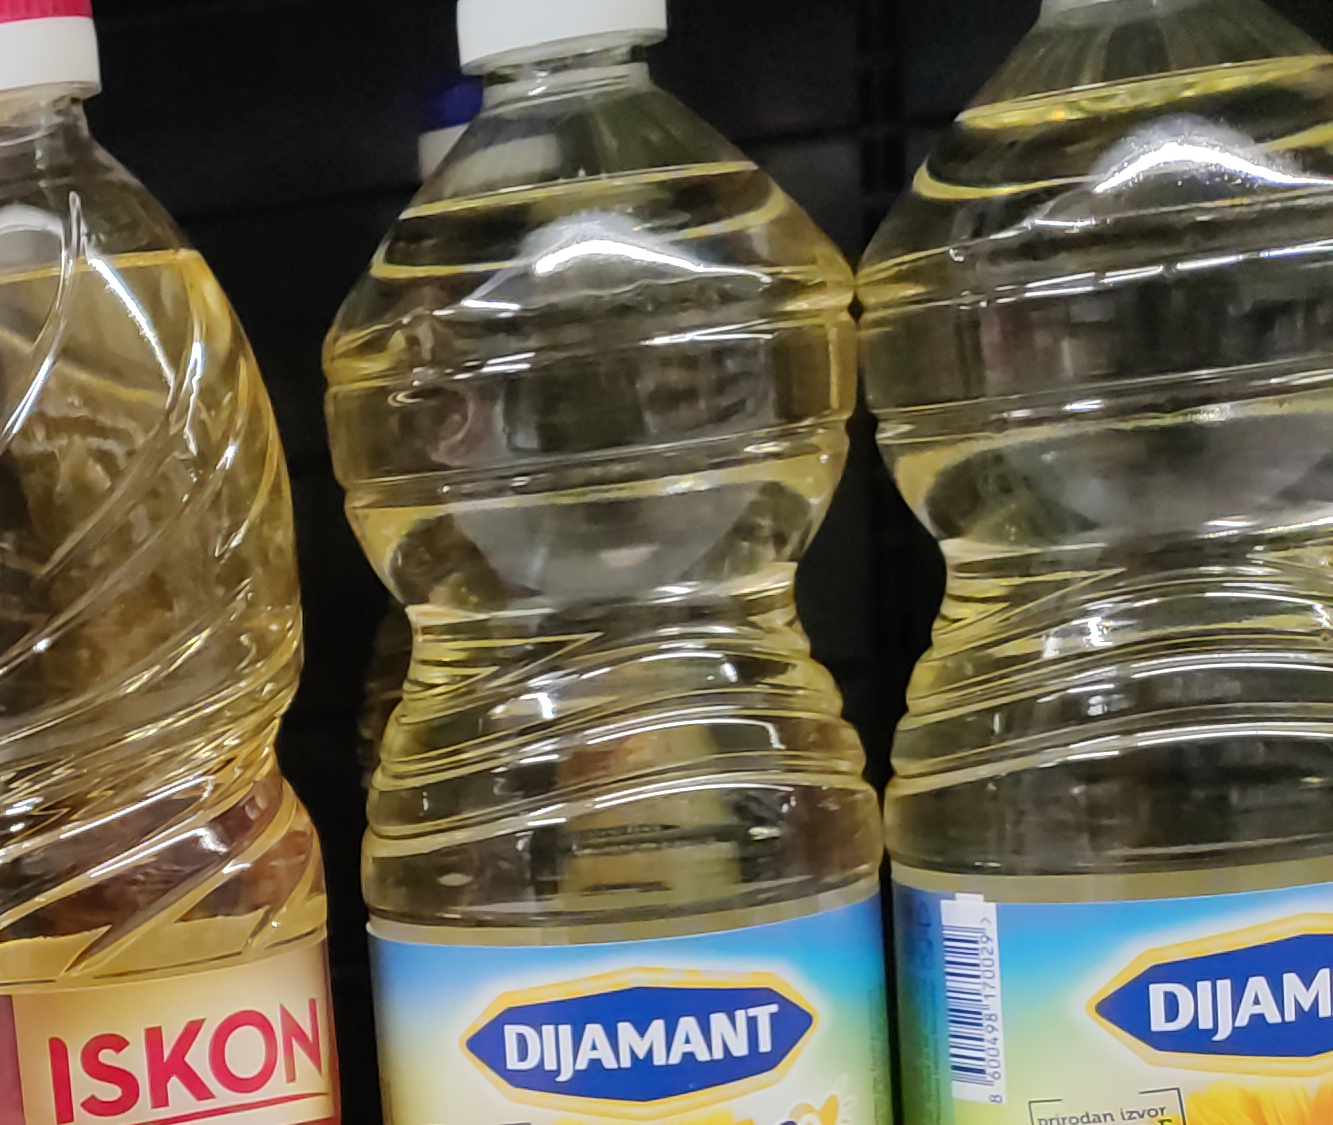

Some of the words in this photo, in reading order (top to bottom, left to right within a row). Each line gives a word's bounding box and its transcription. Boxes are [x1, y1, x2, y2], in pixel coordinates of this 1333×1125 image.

[980, 934, 996, 1000] 170029
[1149, 967, 1332, 1041] DIJAM
[48, 998, 324, 1125] ISKON
[503, 1003, 779, 1083] DIJAMANT
[984, 1012, 1002, 1081] 600498
[1120, 1105, 1167, 1122] izvor
